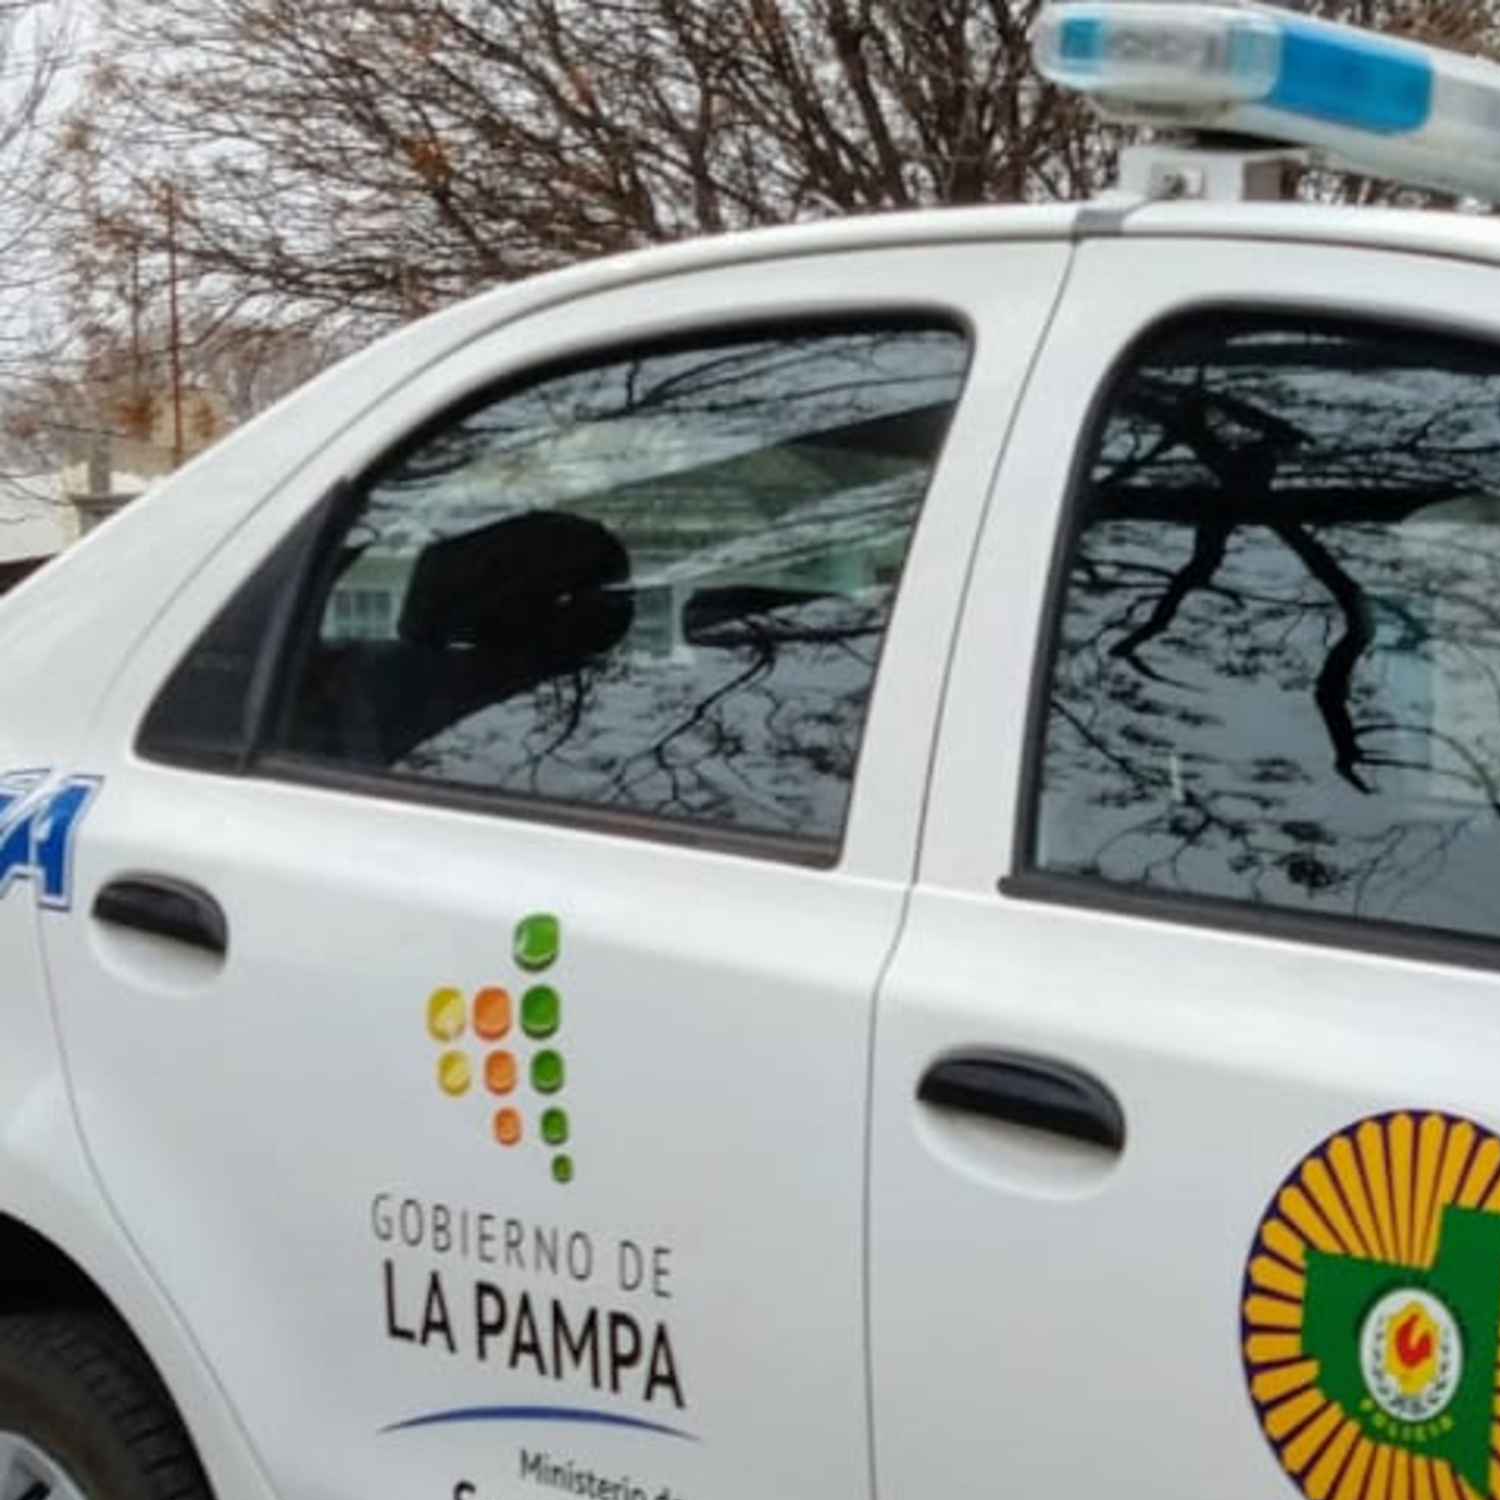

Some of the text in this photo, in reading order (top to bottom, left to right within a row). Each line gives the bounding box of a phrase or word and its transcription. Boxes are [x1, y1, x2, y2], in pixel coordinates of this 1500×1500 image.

[371, 1194, 674, 1299] GOBIERNO DE
[384, 1258, 686, 1410] LA PAMPA
